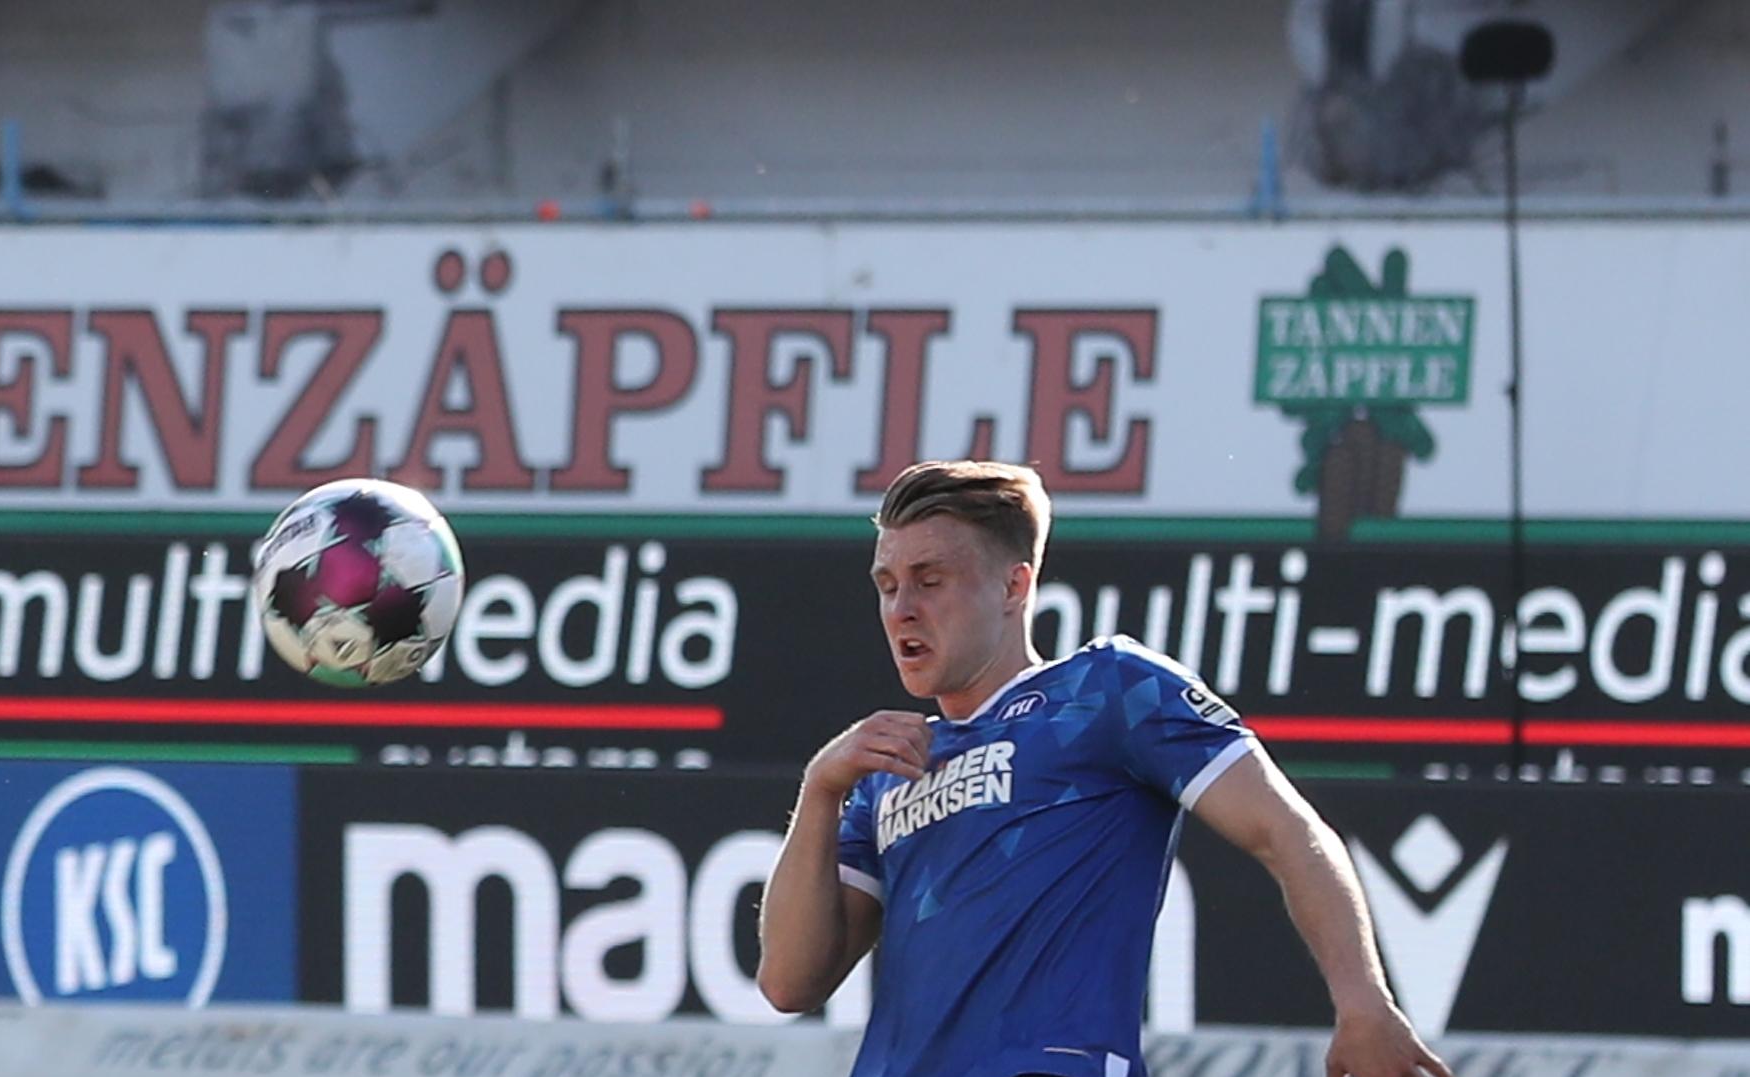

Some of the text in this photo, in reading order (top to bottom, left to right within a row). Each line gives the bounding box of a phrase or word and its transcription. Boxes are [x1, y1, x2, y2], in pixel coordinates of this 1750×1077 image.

[1266, 302, 1467, 347] TANNEN
[876, 772, 1014, 856] MARKISEN
[877, 740, 1017, 823] KLAIBER
[53, 831, 177, 996] KSC
[301, 1035, 410, 1077] are
